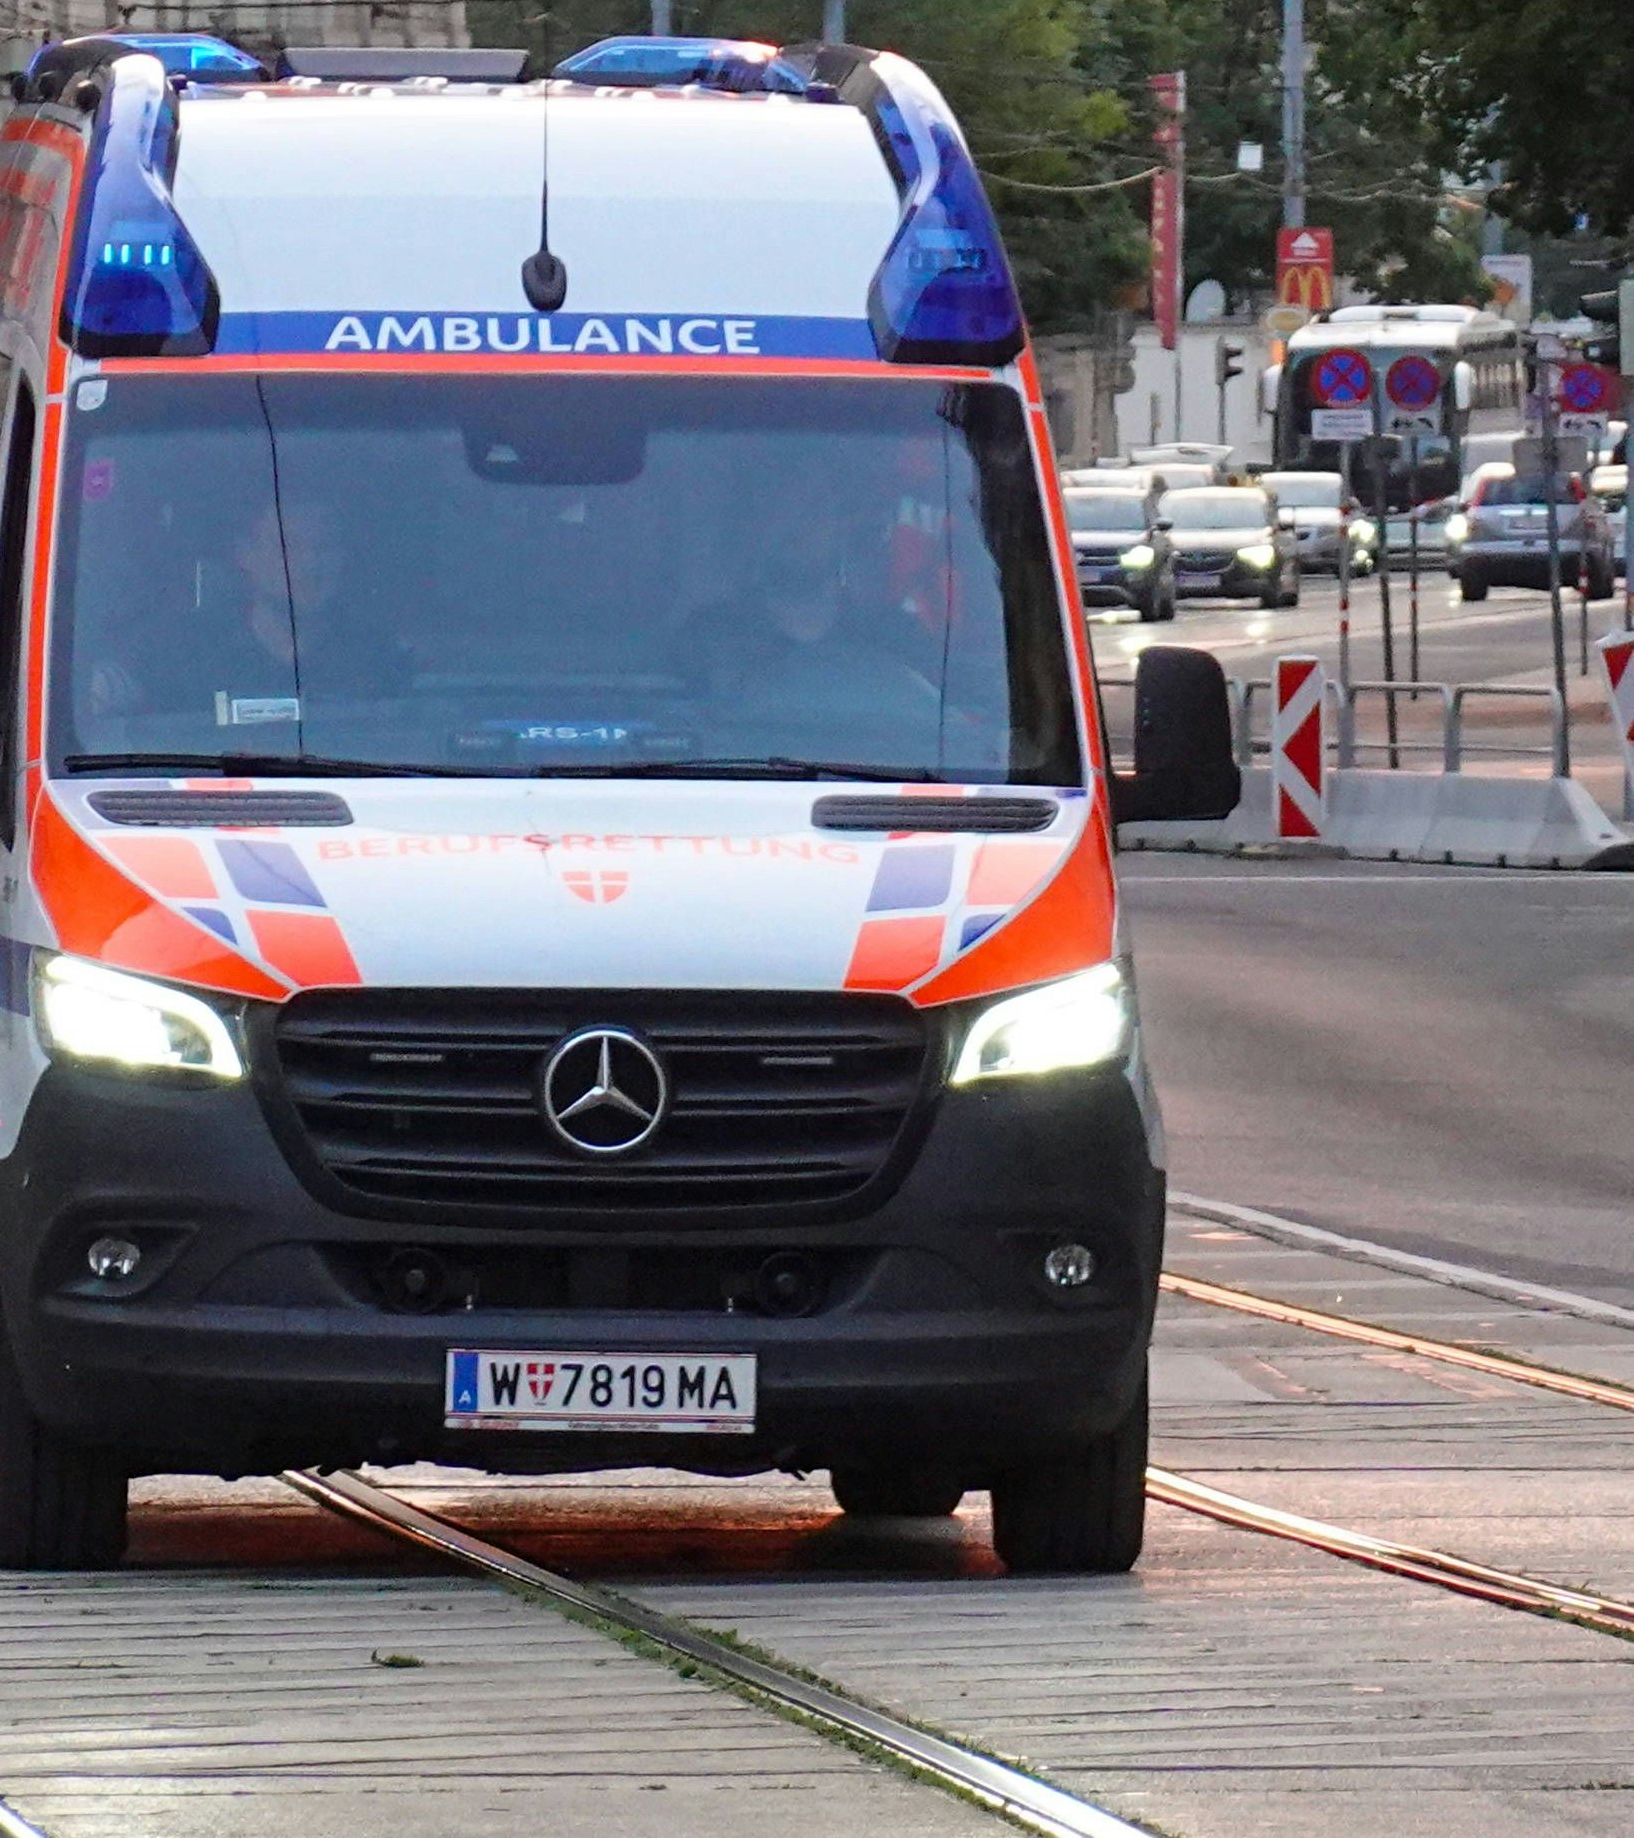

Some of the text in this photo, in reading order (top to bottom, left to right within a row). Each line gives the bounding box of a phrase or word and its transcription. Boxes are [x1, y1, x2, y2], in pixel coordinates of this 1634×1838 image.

[324, 315, 761, 355] AMBULANCE
[317, 833, 860, 864] BERUFSRETTUNG
[490, 1361, 738, 1409] W 7819 MA
